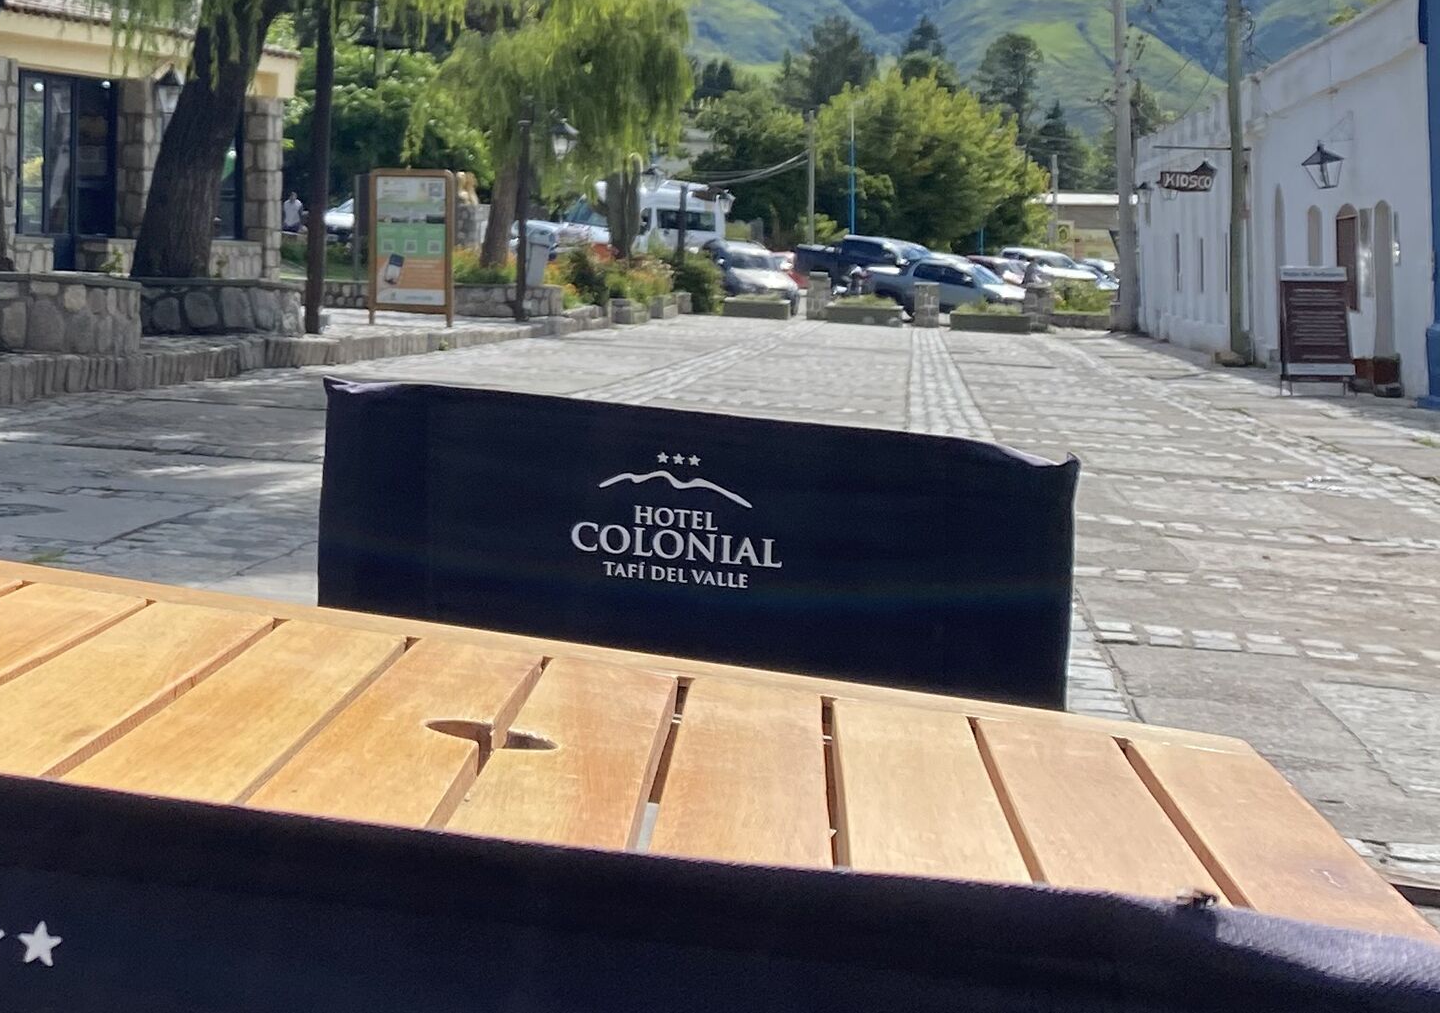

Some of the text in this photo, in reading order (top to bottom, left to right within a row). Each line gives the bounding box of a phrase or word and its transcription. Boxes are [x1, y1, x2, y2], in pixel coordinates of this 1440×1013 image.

[1162, 173, 1212, 189] KIOSCO
[634, 504, 718, 531] HOTEL
[571, 521, 783, 568] COLONIAL
[602, 561, 749, 589] TAFÍ DEL VALLE
